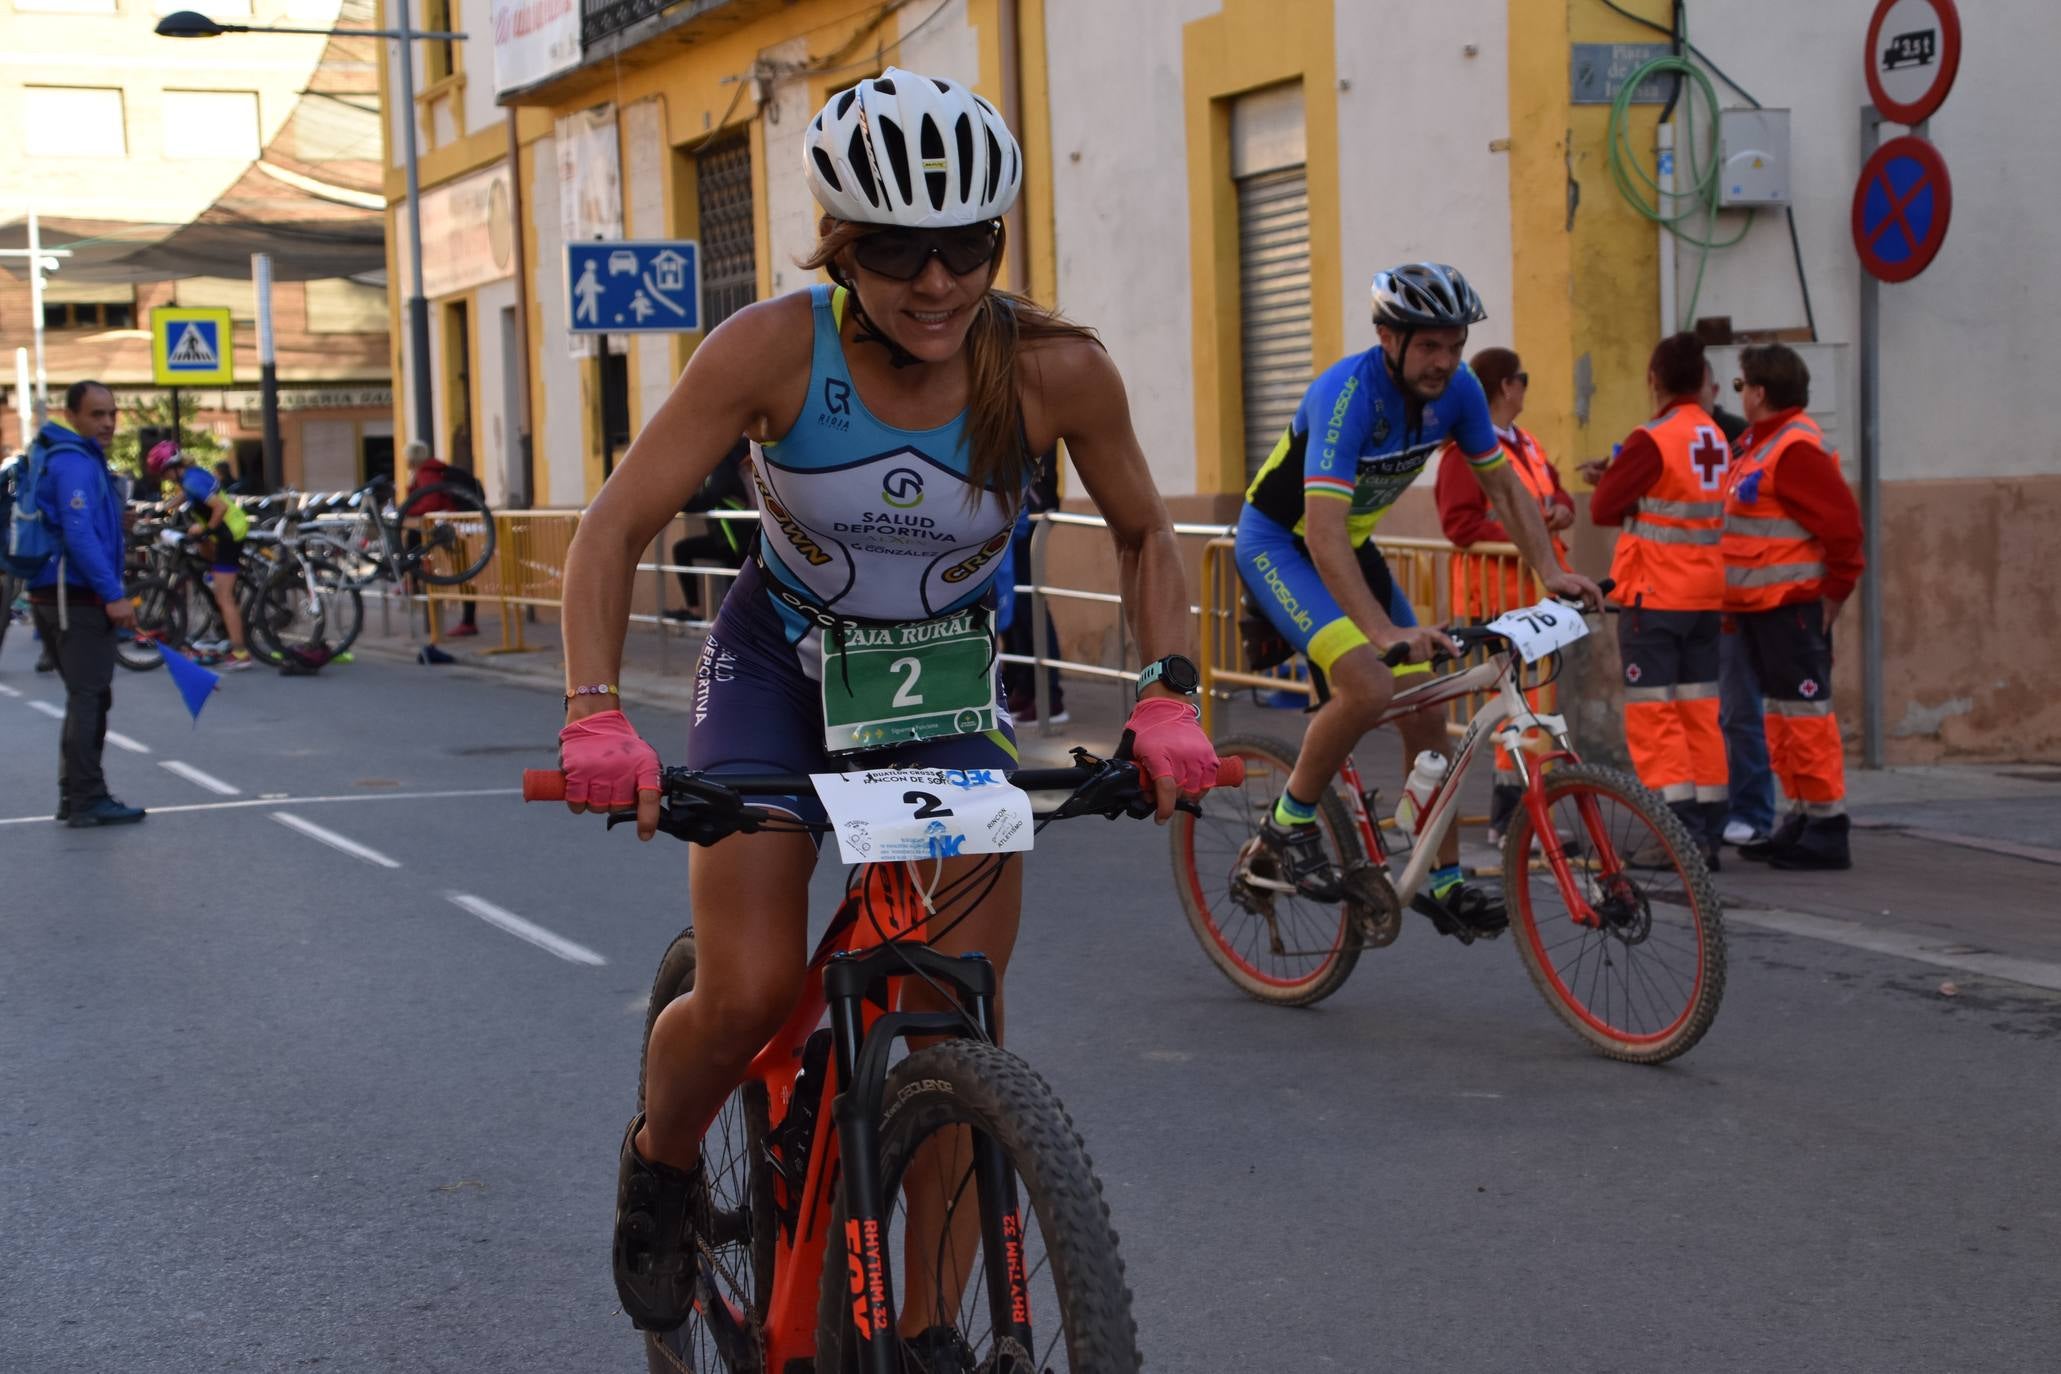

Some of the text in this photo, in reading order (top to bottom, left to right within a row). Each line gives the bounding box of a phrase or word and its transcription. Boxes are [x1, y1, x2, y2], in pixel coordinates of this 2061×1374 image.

[833, 522, 957, 543] DEPORTIVA
[862, 511, 935, 529] SALUD
[1252, 551, 1313, 633] la bascula
[1516, 610, 1558, 634] 76
[695, 634, 719, 727] DEPORTIVA
[889, 657, 923, 708] 2
[903, 791, 954, 820] 2
[864, 1219, 885, 1302] RHYTHM
[1003, 1215, 1026, 1323] RHYTHM 32
[873, 1306, 887, 1329] 32
